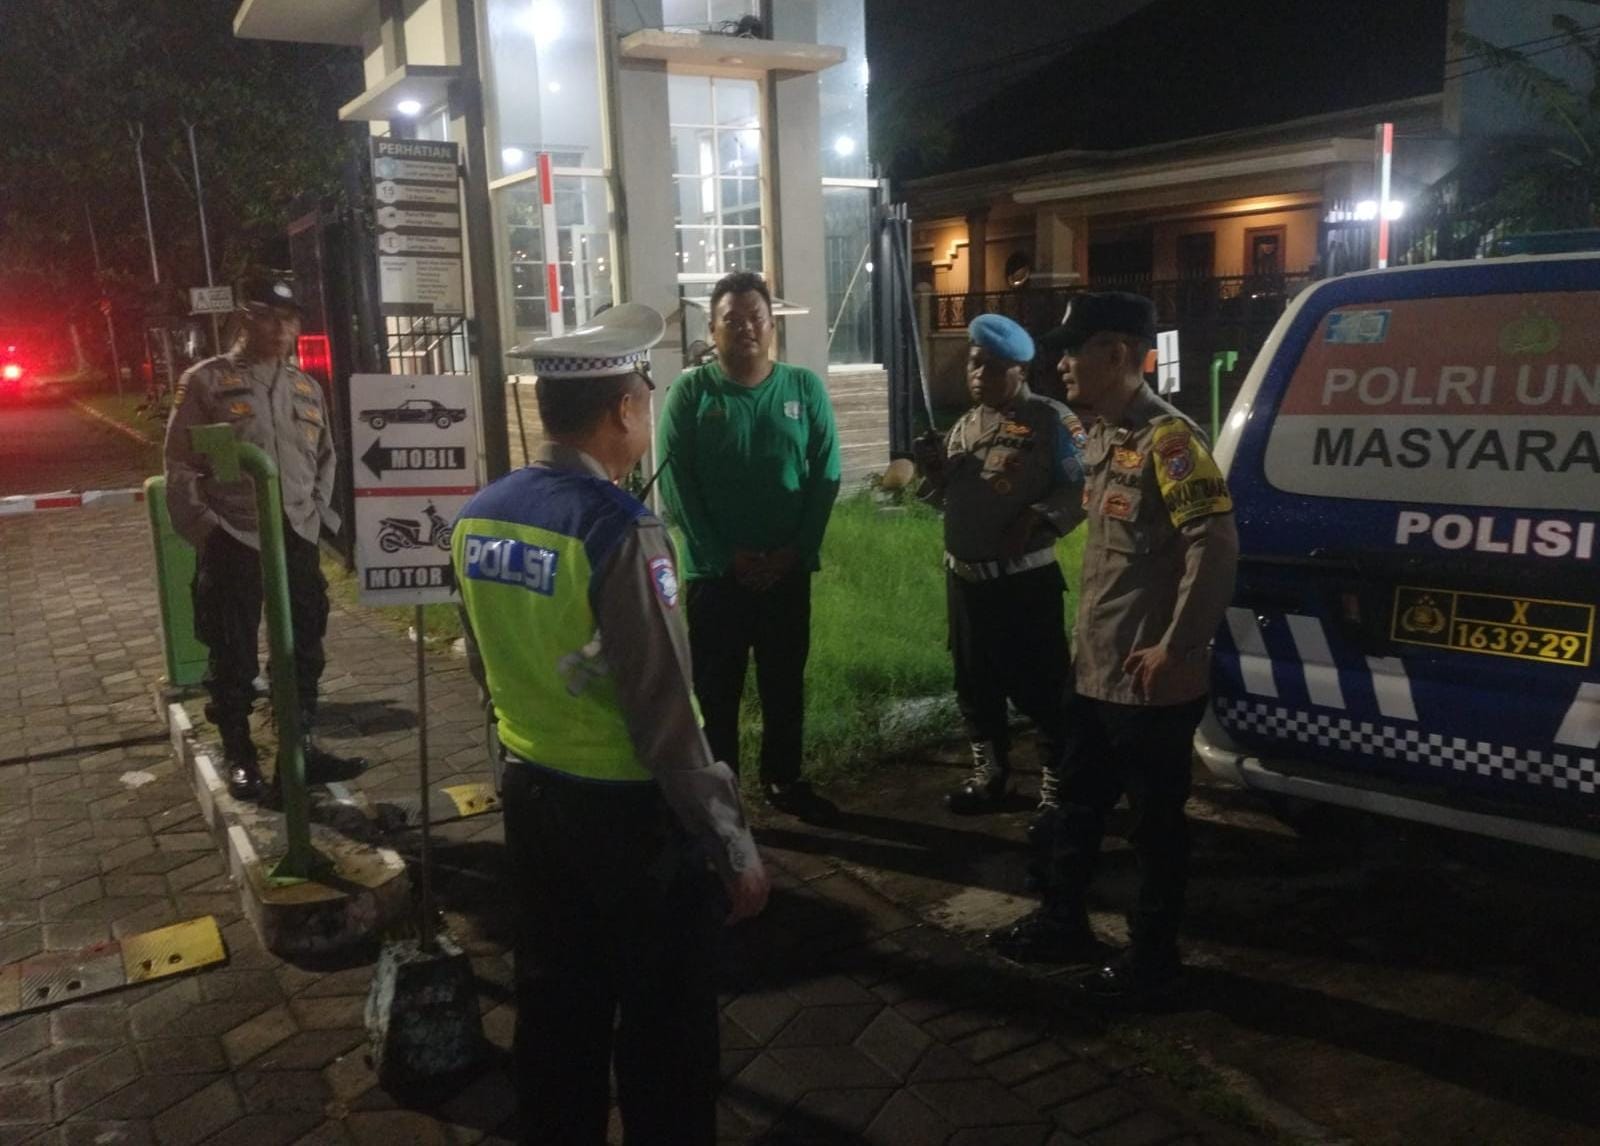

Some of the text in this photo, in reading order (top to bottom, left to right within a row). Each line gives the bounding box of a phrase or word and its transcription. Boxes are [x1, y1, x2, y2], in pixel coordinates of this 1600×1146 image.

[378, 142, 451, 158] PERHATIAN
[1320, 365, 1496, 406] POLRI
[390, 448, 458, 468] MOBIL
[1312, 427, 1600, 474] MASYARA
[1395, 510, 1595, 560] POLISI
[369, 566, 443, 588] MOTOR
[1510, 600, 1530, 625] X
[1457, 623, 1581, 660] 1639-29
